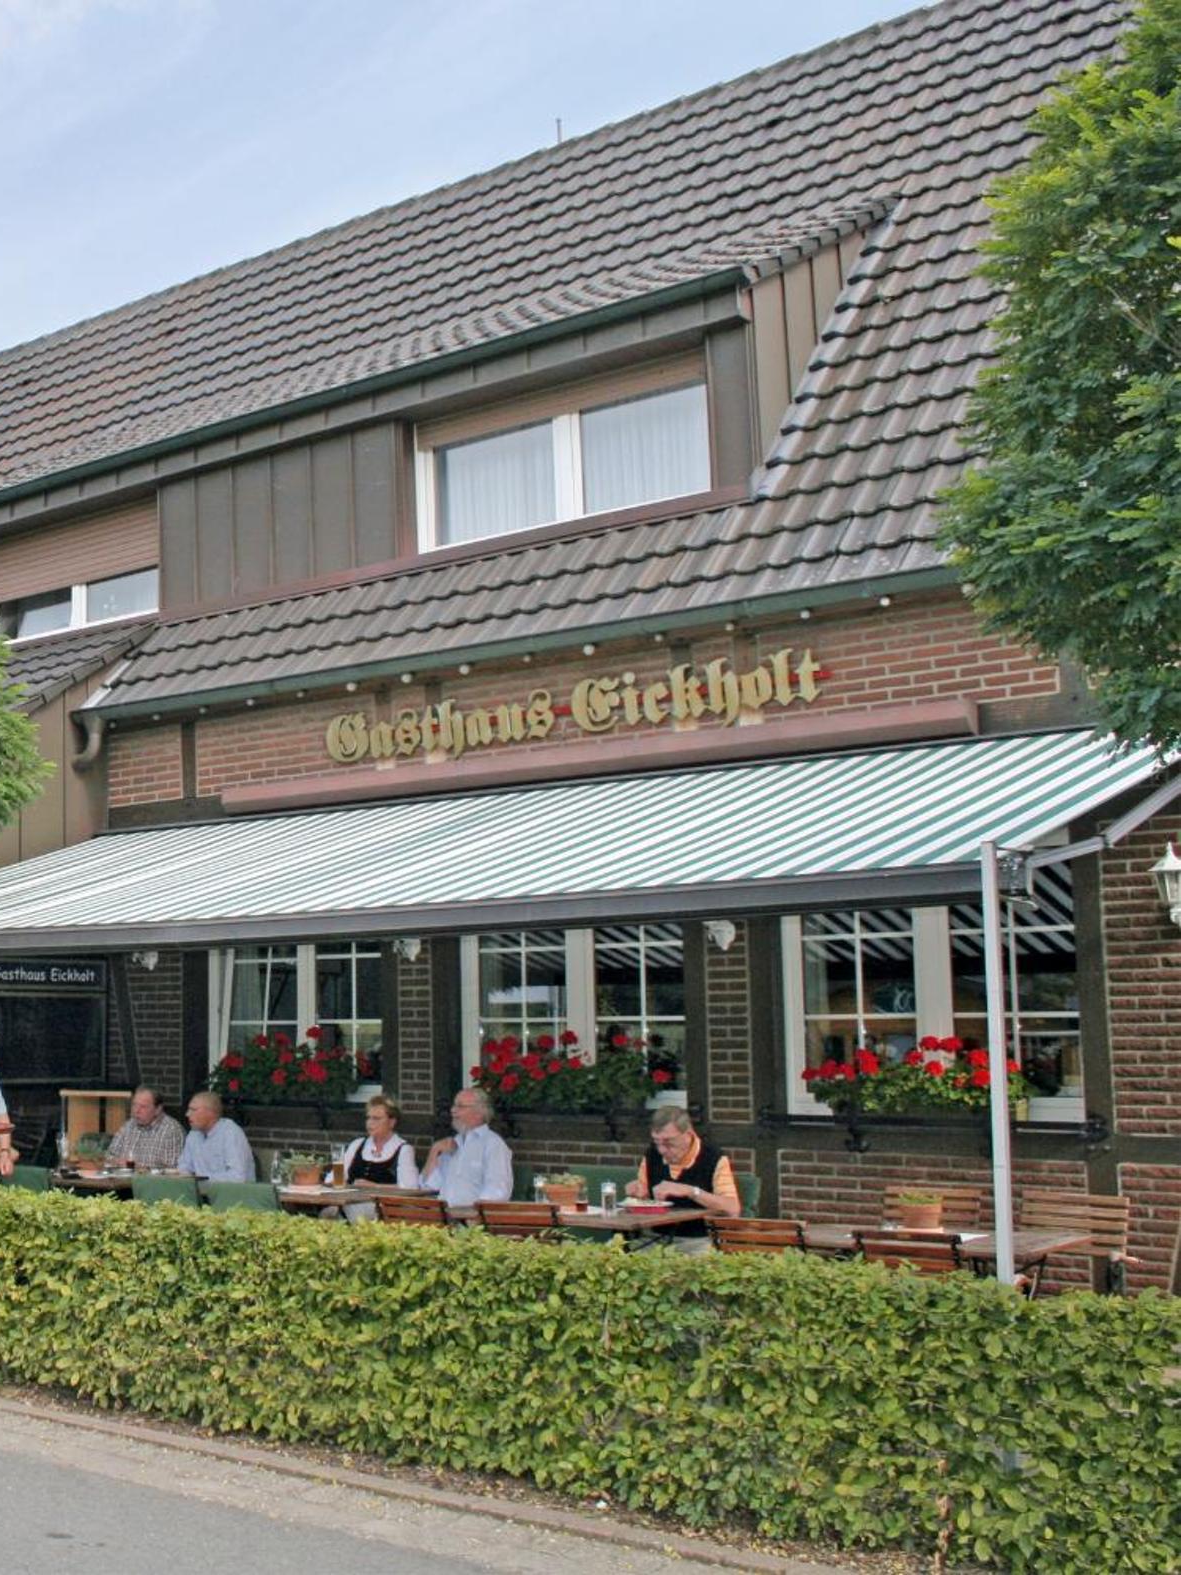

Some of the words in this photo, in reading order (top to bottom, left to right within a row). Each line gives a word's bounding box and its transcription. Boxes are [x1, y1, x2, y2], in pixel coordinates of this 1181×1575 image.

[325, 689, 553, 763] Gasthaus
[571, 647, 823, 733] Eickholt
[50, 967, 95, 982] Eickholt
